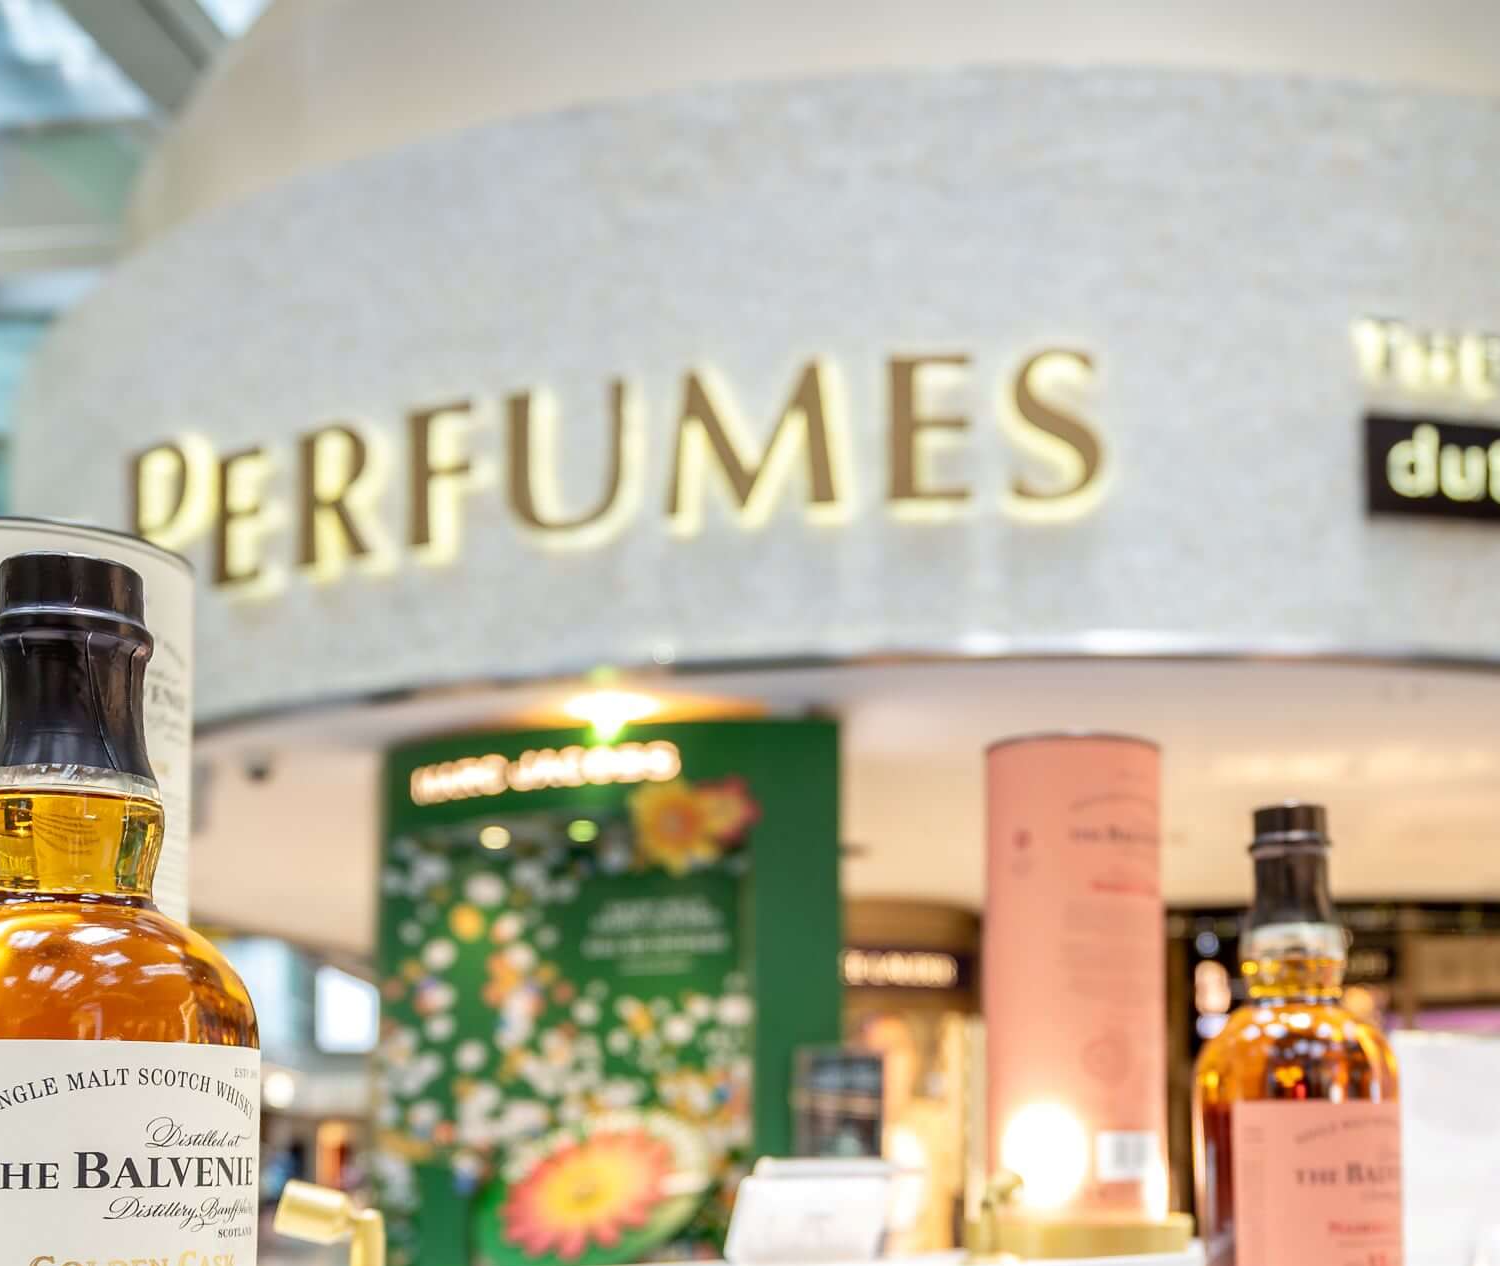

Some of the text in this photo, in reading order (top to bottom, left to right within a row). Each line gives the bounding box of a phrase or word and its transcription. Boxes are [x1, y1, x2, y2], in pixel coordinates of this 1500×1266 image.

[127, 347, 1112, 594] PERFUMES
[67, 1068, 130, 1092] MALT
[138, 1068, 212, 1093] SCOTCH
[216, 1079, 255, 1121] WHISKY
[145, 1116, 227, 1149] Distilled
[73, 1151, 254, 1190] BALVENIE
[103, 1195, 199, 1231] Distillery,
